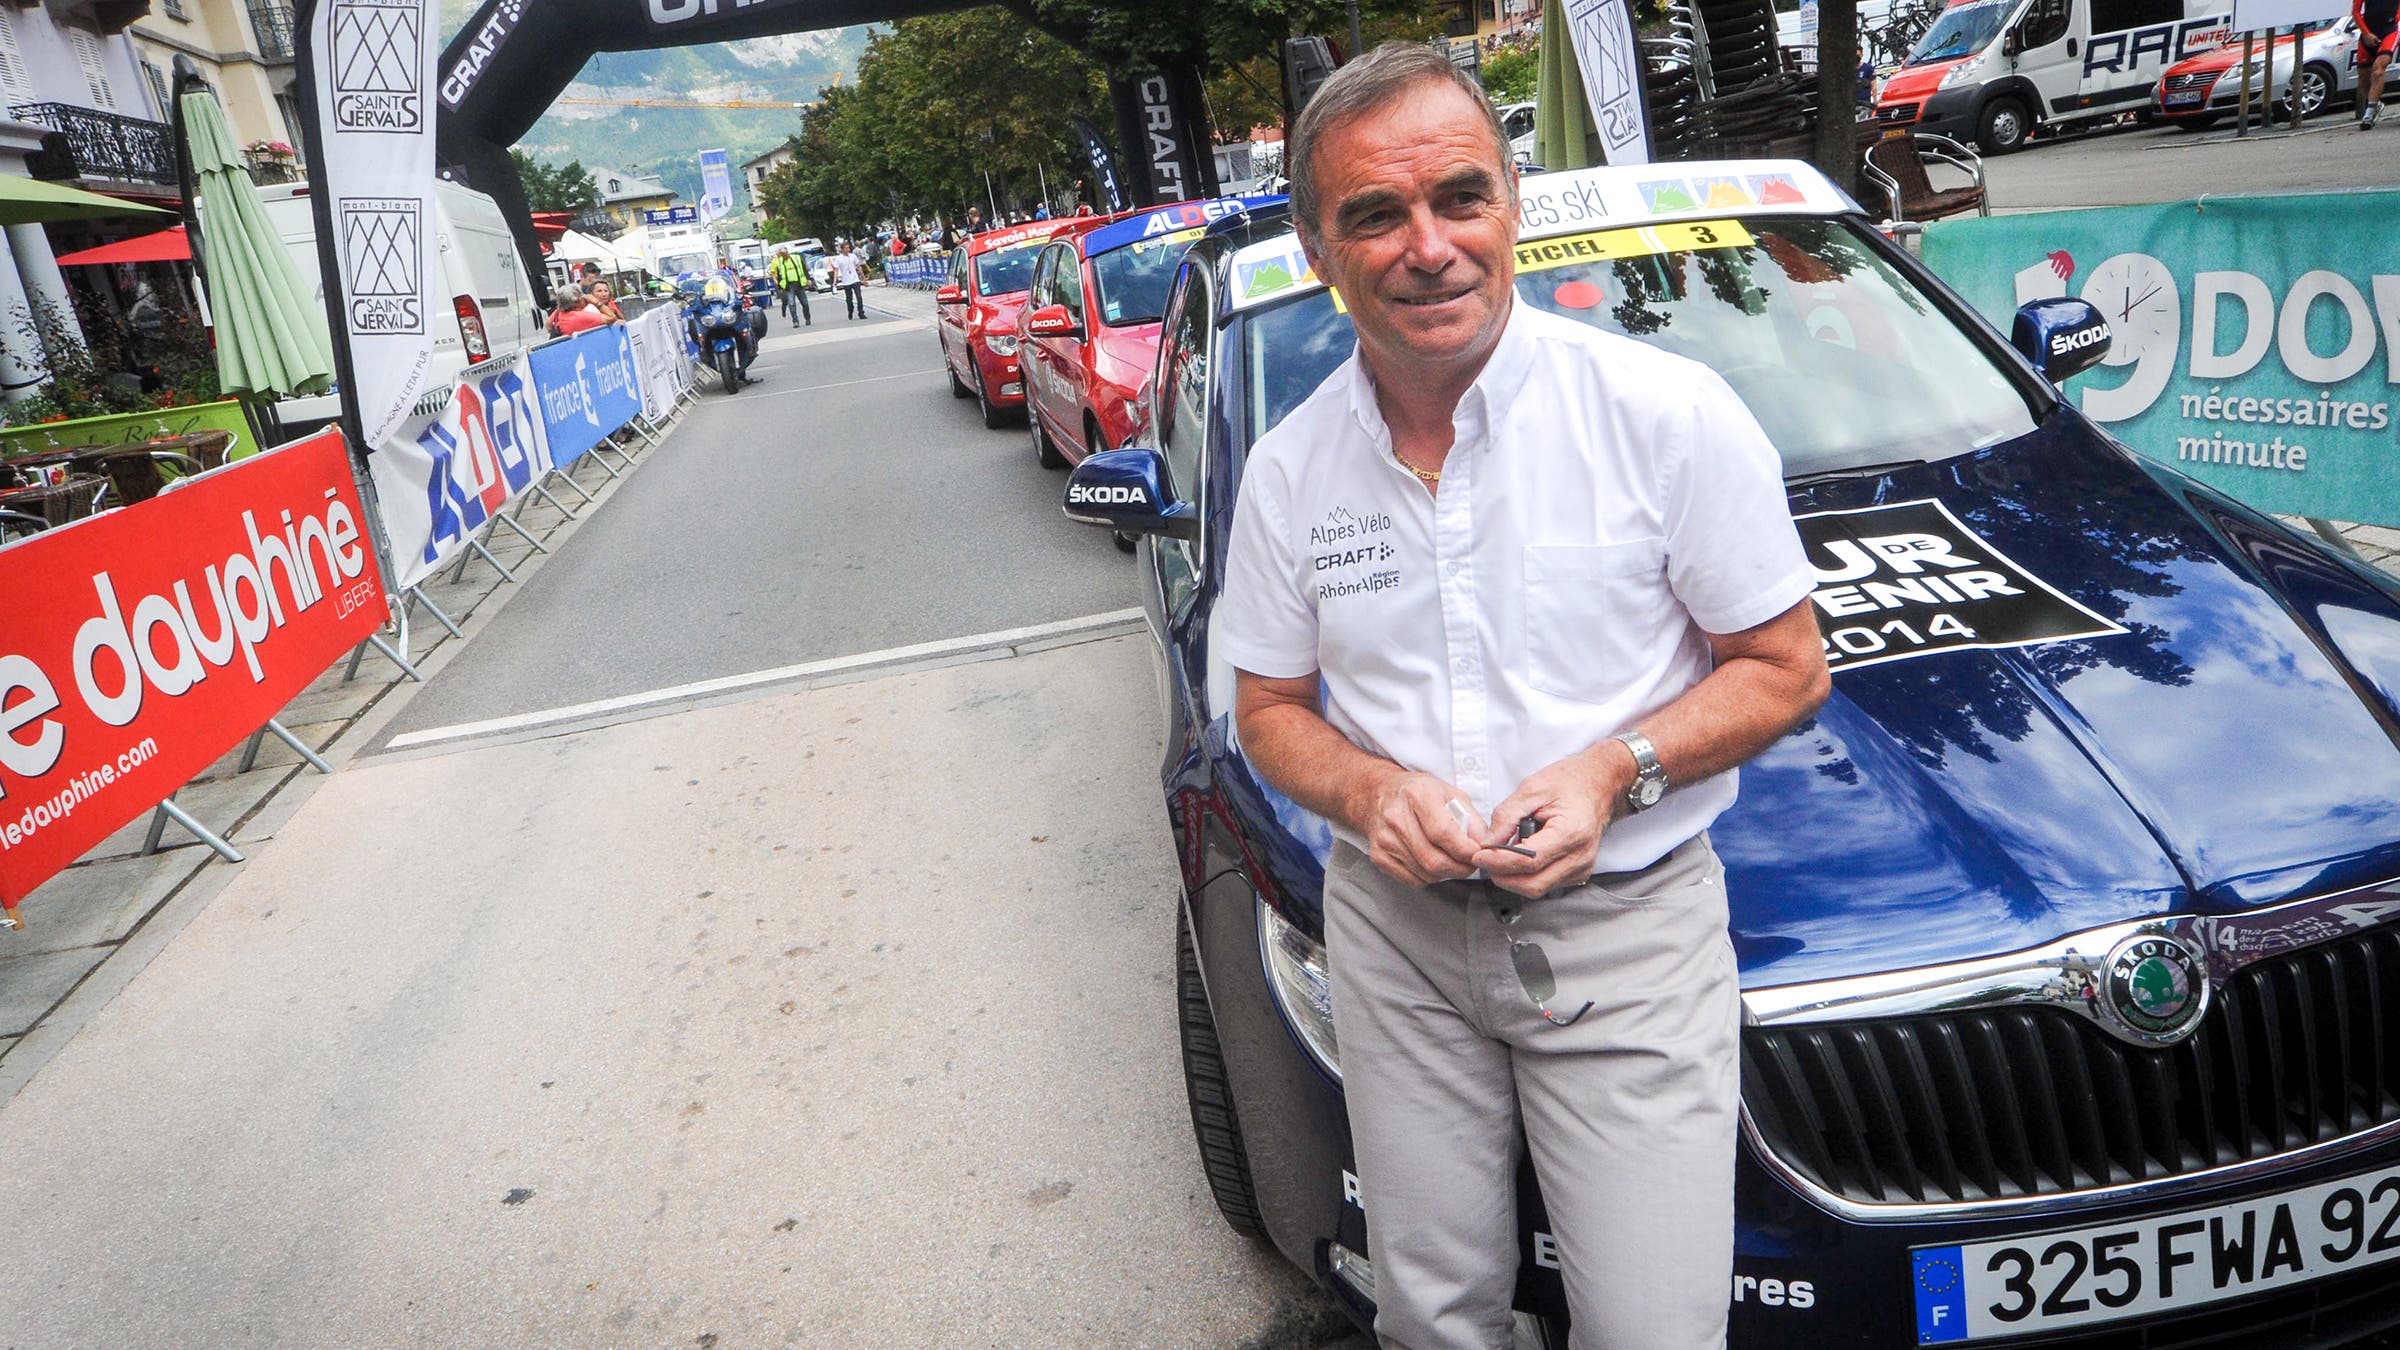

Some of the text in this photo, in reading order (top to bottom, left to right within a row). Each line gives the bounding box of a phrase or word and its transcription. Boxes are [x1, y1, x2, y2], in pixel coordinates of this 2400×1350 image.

[441, 13, 506, 105] CRAFT
[2083, 16, 2231, 79] RAC
[337, 95, 419, 127] GERVAIS
[355, 95, 400, 110] SAINT
[1141, 76, 1186, 202] CRAFT
[343, 201, 417, 209] mont-blanc
[1519, 180, 1609, 231] es.ski
[984, 229, 1025, 249] Savoie
[1515, 225, 1719, 265] FICIEL 3
[352, 298, 420, 330] GERVAIS
[1031, 318, 1064, 329] ŠKODA
[2051, 322, 2113, 356] ŠKODA
[595, 359, 624, 397] france
[543, 380, 581, 425] france
[2180, 385, 2389, 430] nécessaires
[2177, 430, 2308, 471] minute
[1069, 484, 1147, 503] ŠKODA
[1310, 513, 1392, 547] Alpes Vélo
[1883, 539, 1936, 554] DE
[1315, 546, 1376, 571] CRAFT
[1373, 569, 1400, 579] Région
[0, 654, 65, 778] e
[0, 735, 159, 850] ledauphine.com
[1986, 1176, 2400, 1323] 325 FWA 92
[1931, 1304, 1950, 1326] F
